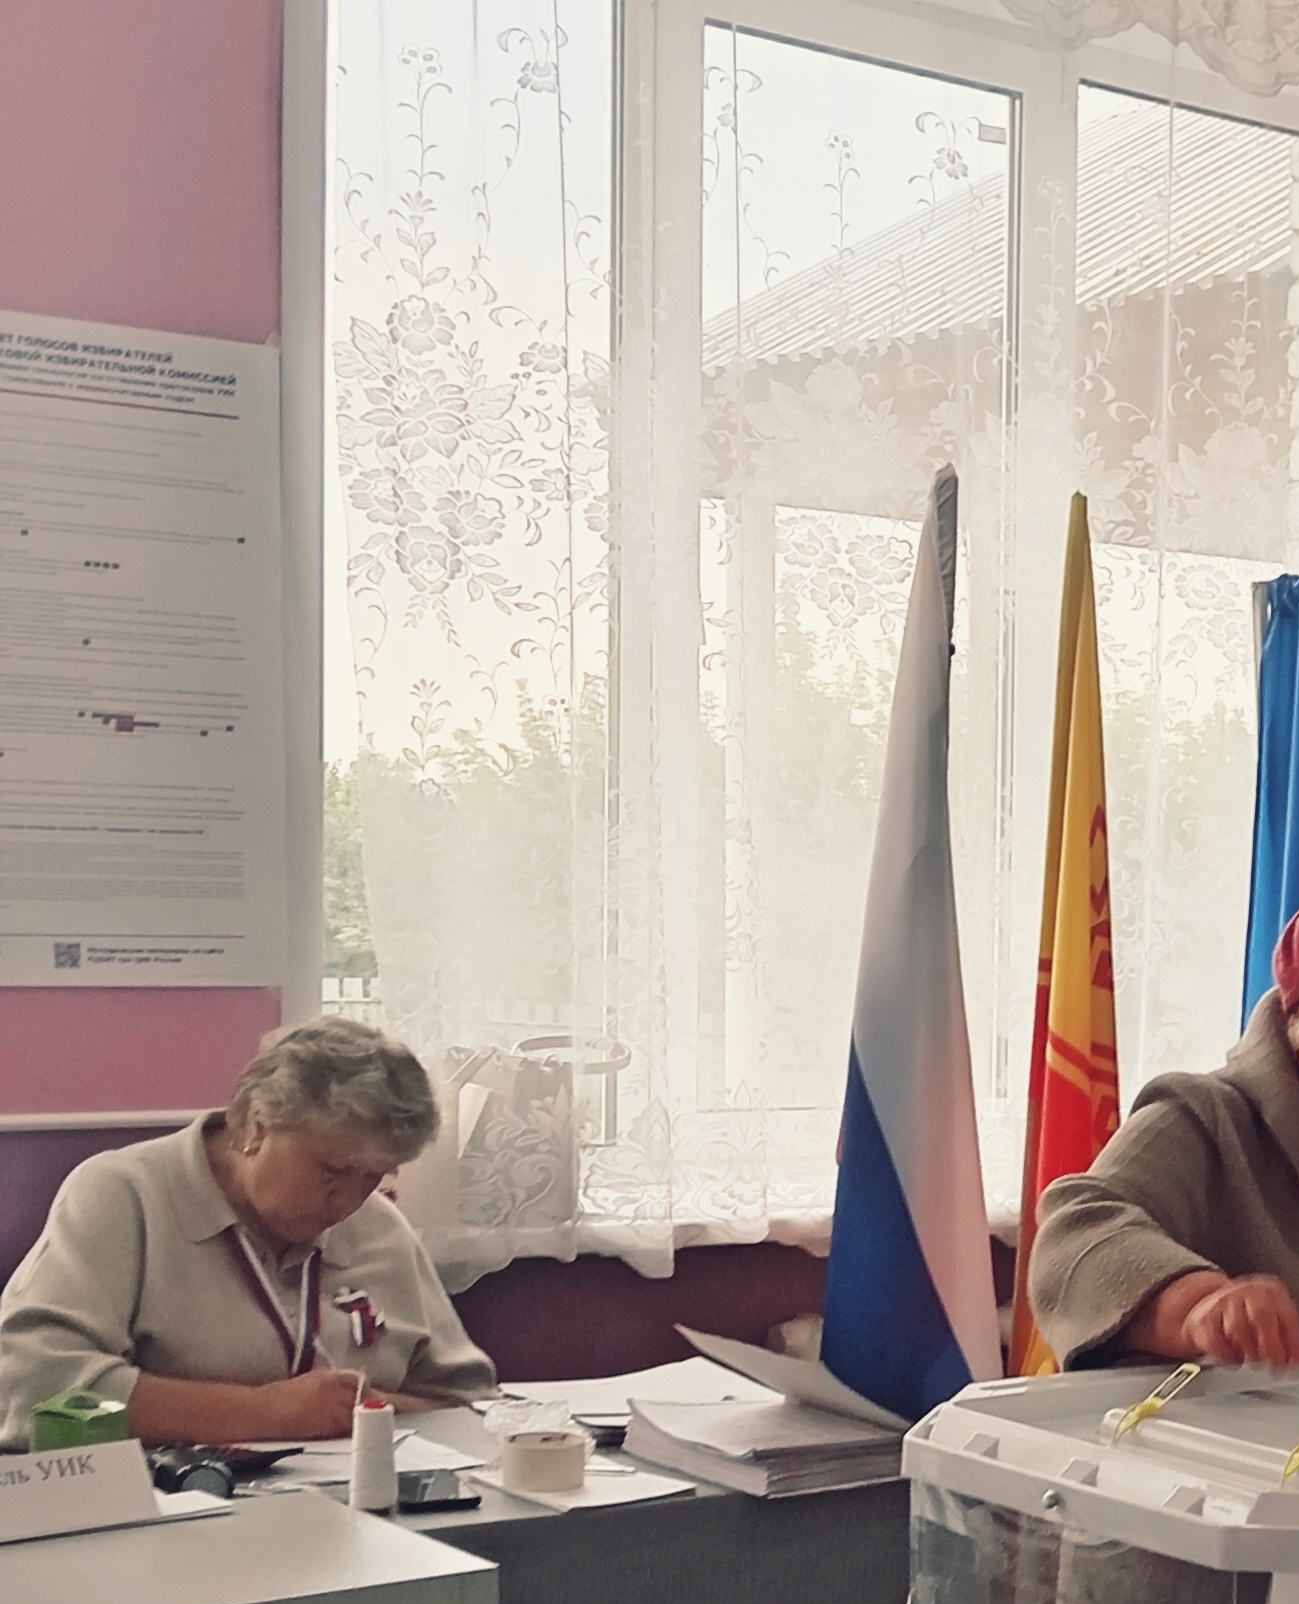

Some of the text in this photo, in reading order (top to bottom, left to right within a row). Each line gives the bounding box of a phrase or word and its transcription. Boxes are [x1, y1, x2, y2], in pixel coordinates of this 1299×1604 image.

[82, 344, 172, 363] ИЗБИРАТЕЛЕЙ
[46, 353, 156, 376] ИЗБИРАТЕЛЬНОЙ
[159, 368, 236, 386] КОМИССИЕЙ
[35, 1453, 96, 1482] УИК
